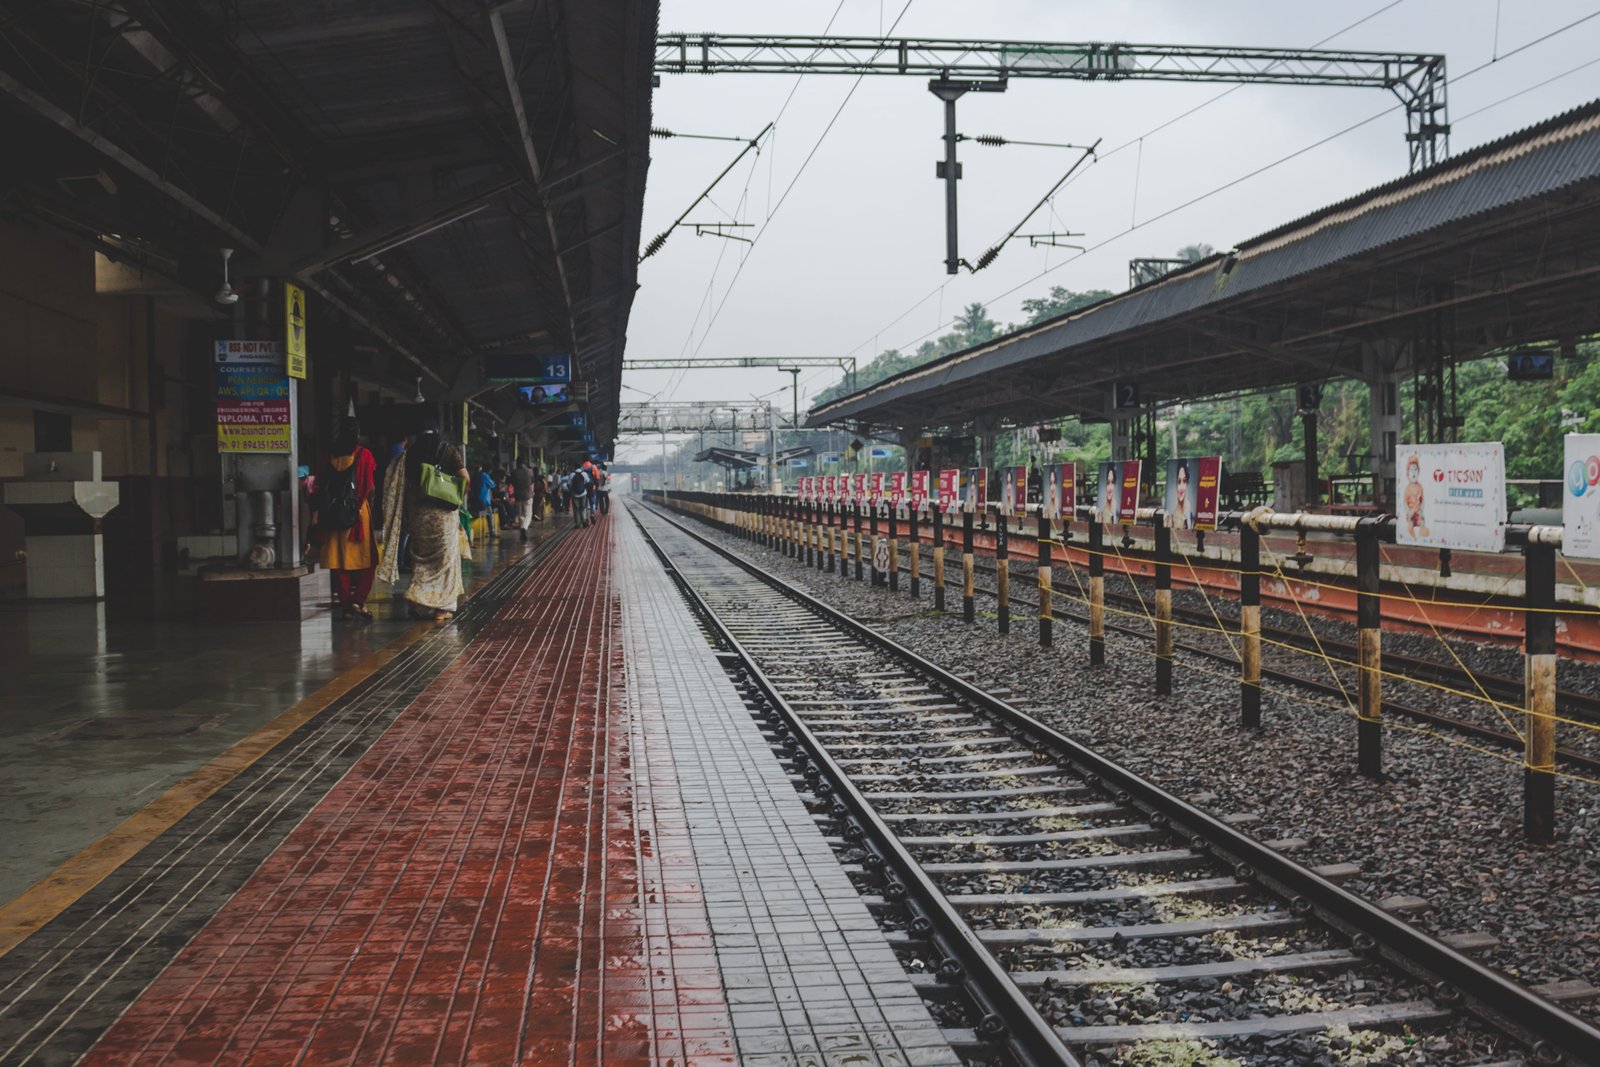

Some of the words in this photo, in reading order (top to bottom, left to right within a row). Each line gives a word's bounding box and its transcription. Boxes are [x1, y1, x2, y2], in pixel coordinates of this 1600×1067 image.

[229, 342, 241, 352] BSS
[243, 342, 257, 353] NDT
[547, 364, 566, 377] 13
[1122, 384, 1134, 406] 2
[218, 415, 259, 424] DIPLOMA,
[261, 415, 275, 424] ITI,
[573, 416, 583, 425] 12
[222, 427, 284, 435] www.bssndt.com
[231, 440, 240, 449] 91
[1448, 469, 1483, 483] TICSON
